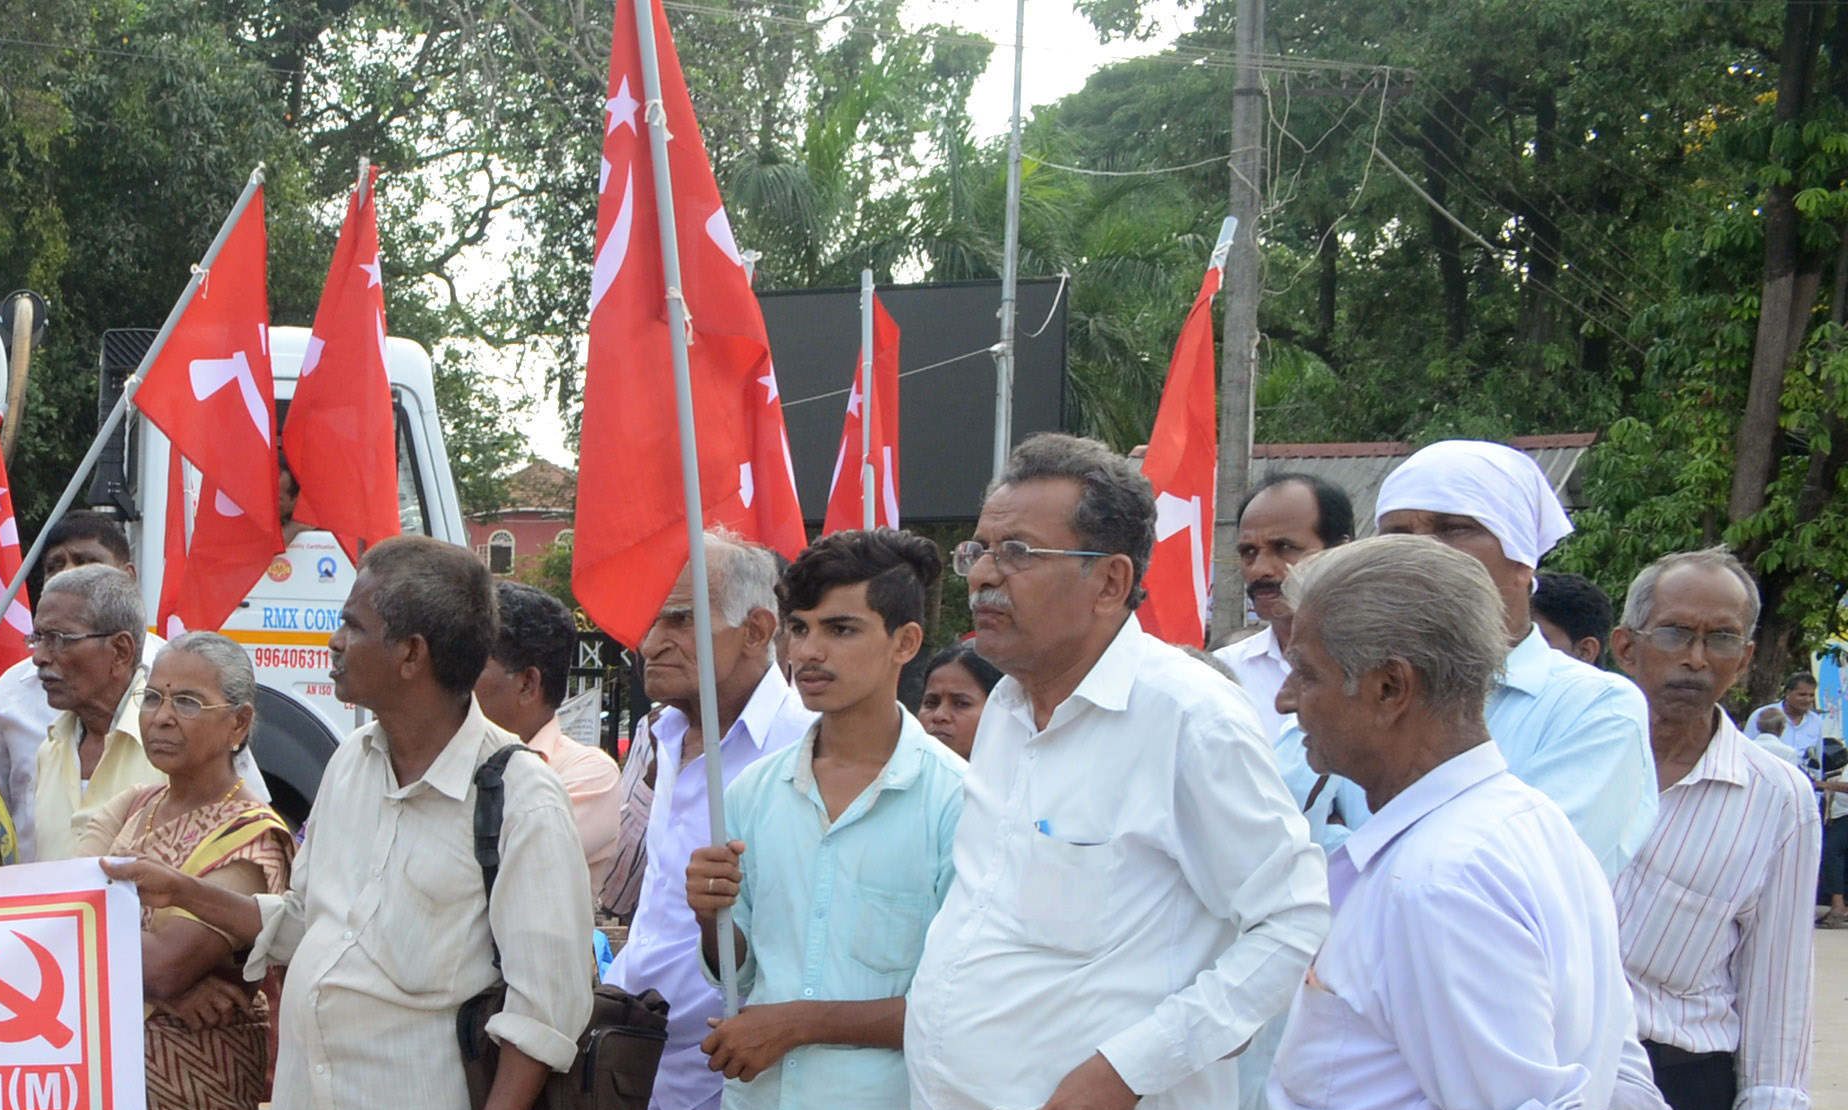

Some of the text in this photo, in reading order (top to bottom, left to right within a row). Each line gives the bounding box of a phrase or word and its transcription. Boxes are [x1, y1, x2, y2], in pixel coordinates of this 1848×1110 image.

[262, 606, 299, 630] RMX
[255, 647, 337, 670] 996406311
[319, 685, 332, 696] ISO
